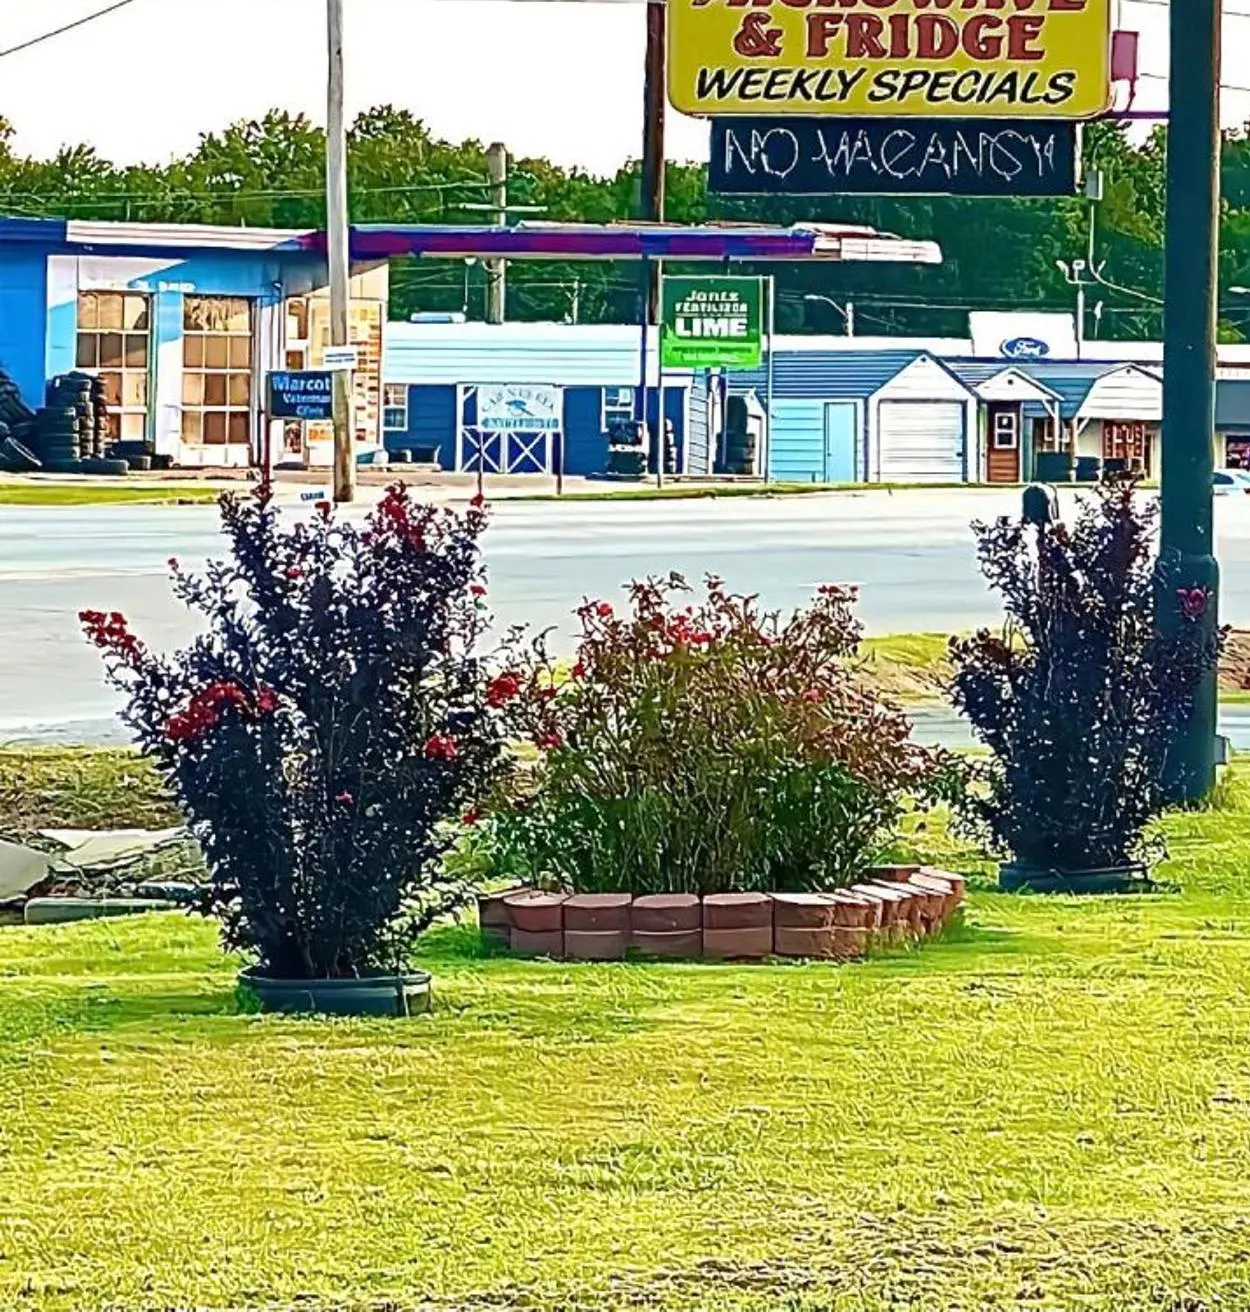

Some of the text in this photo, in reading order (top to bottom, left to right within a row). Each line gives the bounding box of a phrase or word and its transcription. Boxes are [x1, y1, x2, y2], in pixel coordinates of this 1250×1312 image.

[733, 12, 1046, 61] & FRIDGE
[697, 67, 1077, 105] WEEKLY SPECIALS
[725, 128, 800, 177] NO
[675, 317, 748, 338] LIME
